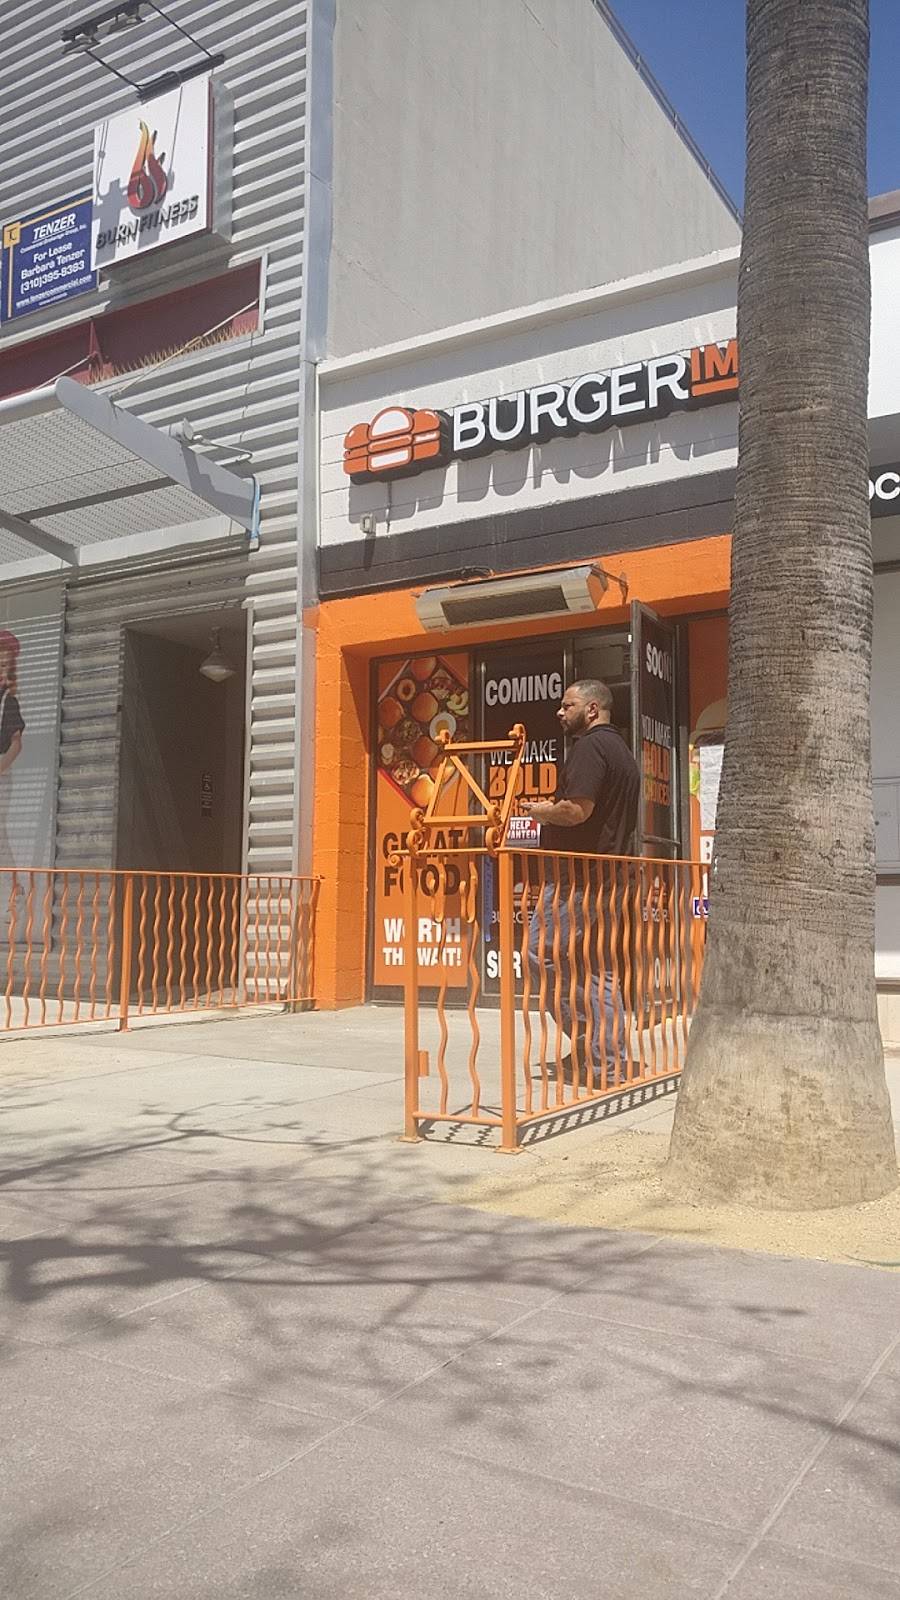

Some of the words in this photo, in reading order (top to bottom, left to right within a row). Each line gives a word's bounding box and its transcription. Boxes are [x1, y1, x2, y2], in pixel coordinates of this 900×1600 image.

[33, 213, 76, 240] TENZER
[21, 260, 55, 279] Barbara
[56, 249, 85, 265] Tenzer
[33, 252, 47, 263] For
[48, 242, 72, 258] Lease
[646, 642, 672, 685] SOON!
[485, 672, 562, 706] COMING
[489, 763, 557, 798] BOLD
[510, 820, 531, 830] HELP
[384, 917, 461, 943] WRTH
[383, 947, 405, 966] TH
